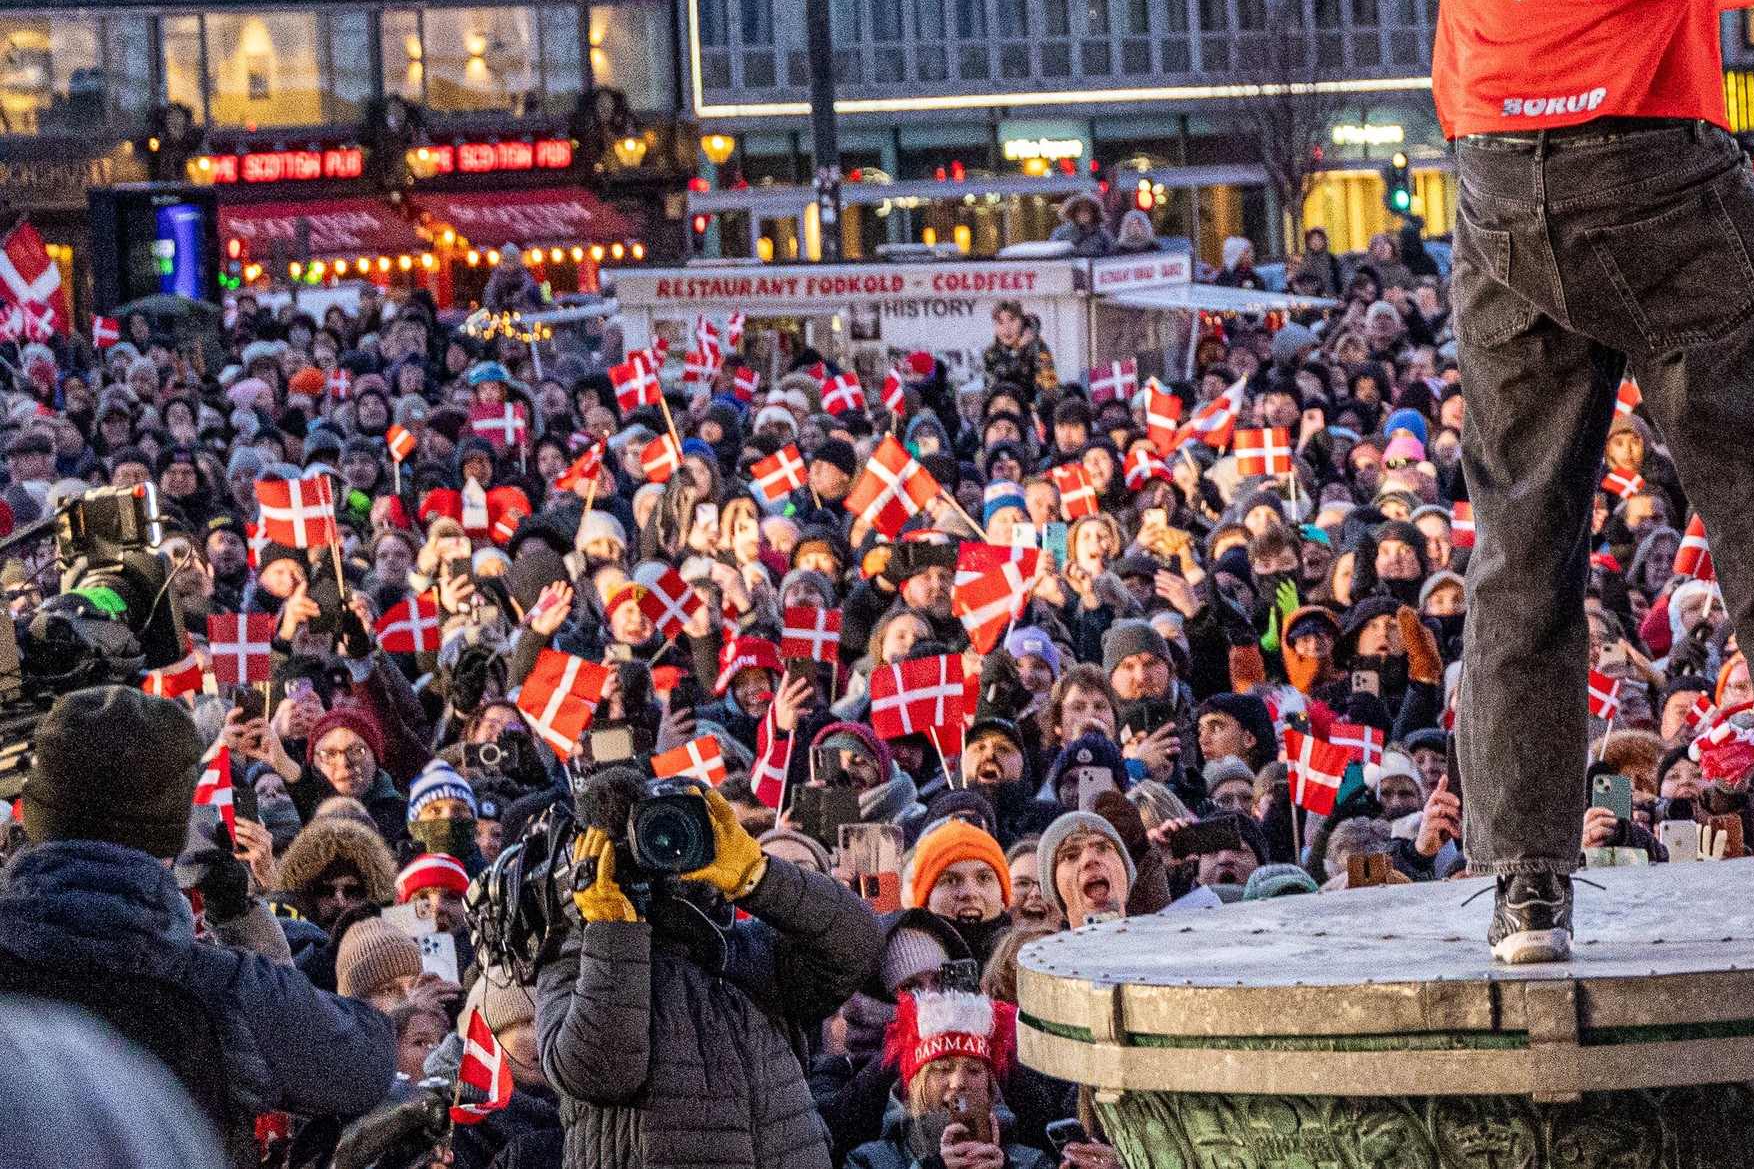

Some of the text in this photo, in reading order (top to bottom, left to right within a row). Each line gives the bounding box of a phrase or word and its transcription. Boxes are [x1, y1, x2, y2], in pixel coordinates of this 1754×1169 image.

[656, 278, 799, 299] RESTAURANT
[806, 275, 905, 296] FODKOLD
[932, 271, 1037, 292] COLDFEET
[884, 297, 978, 319] HISTORY
